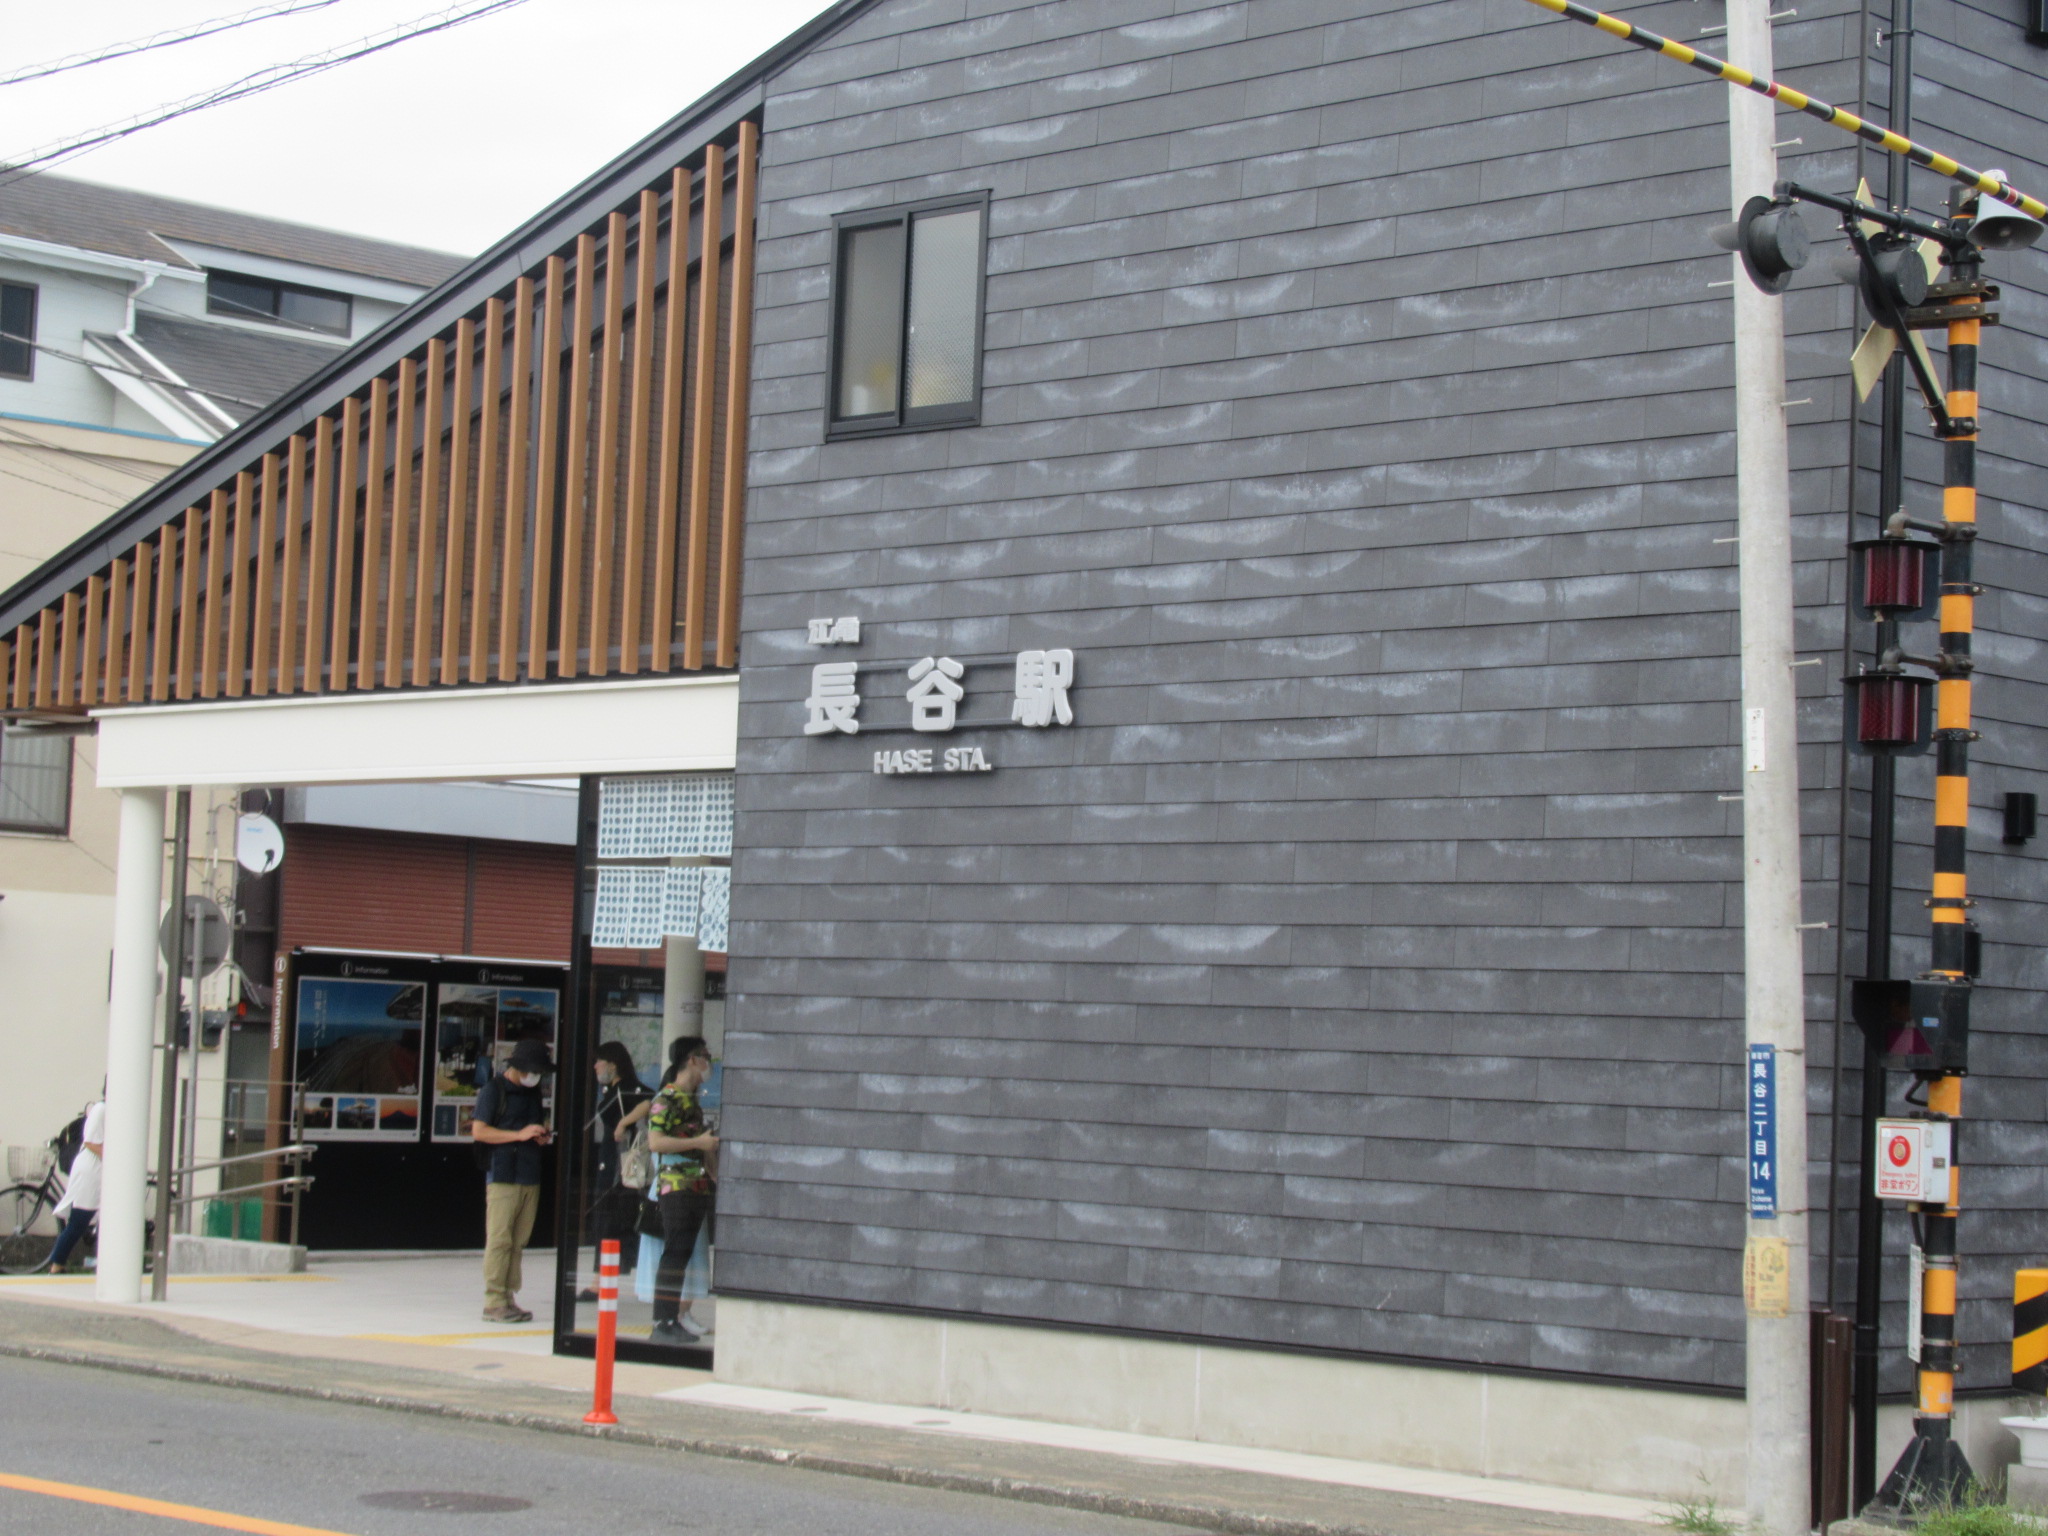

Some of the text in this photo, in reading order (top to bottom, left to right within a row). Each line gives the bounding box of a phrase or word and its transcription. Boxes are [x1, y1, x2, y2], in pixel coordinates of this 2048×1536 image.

[803, 648, 1074, 735] 長谷駅
[873, 747, 992, 774] HASE STA.
[272, 977, 284, 1049] Information
[1753, 1063, 1768, 1155] 長谷二丁目
[1752, 1161, 1771, 1181] 14
[1881, 1179, 1919, 1193] 非常ボタン
